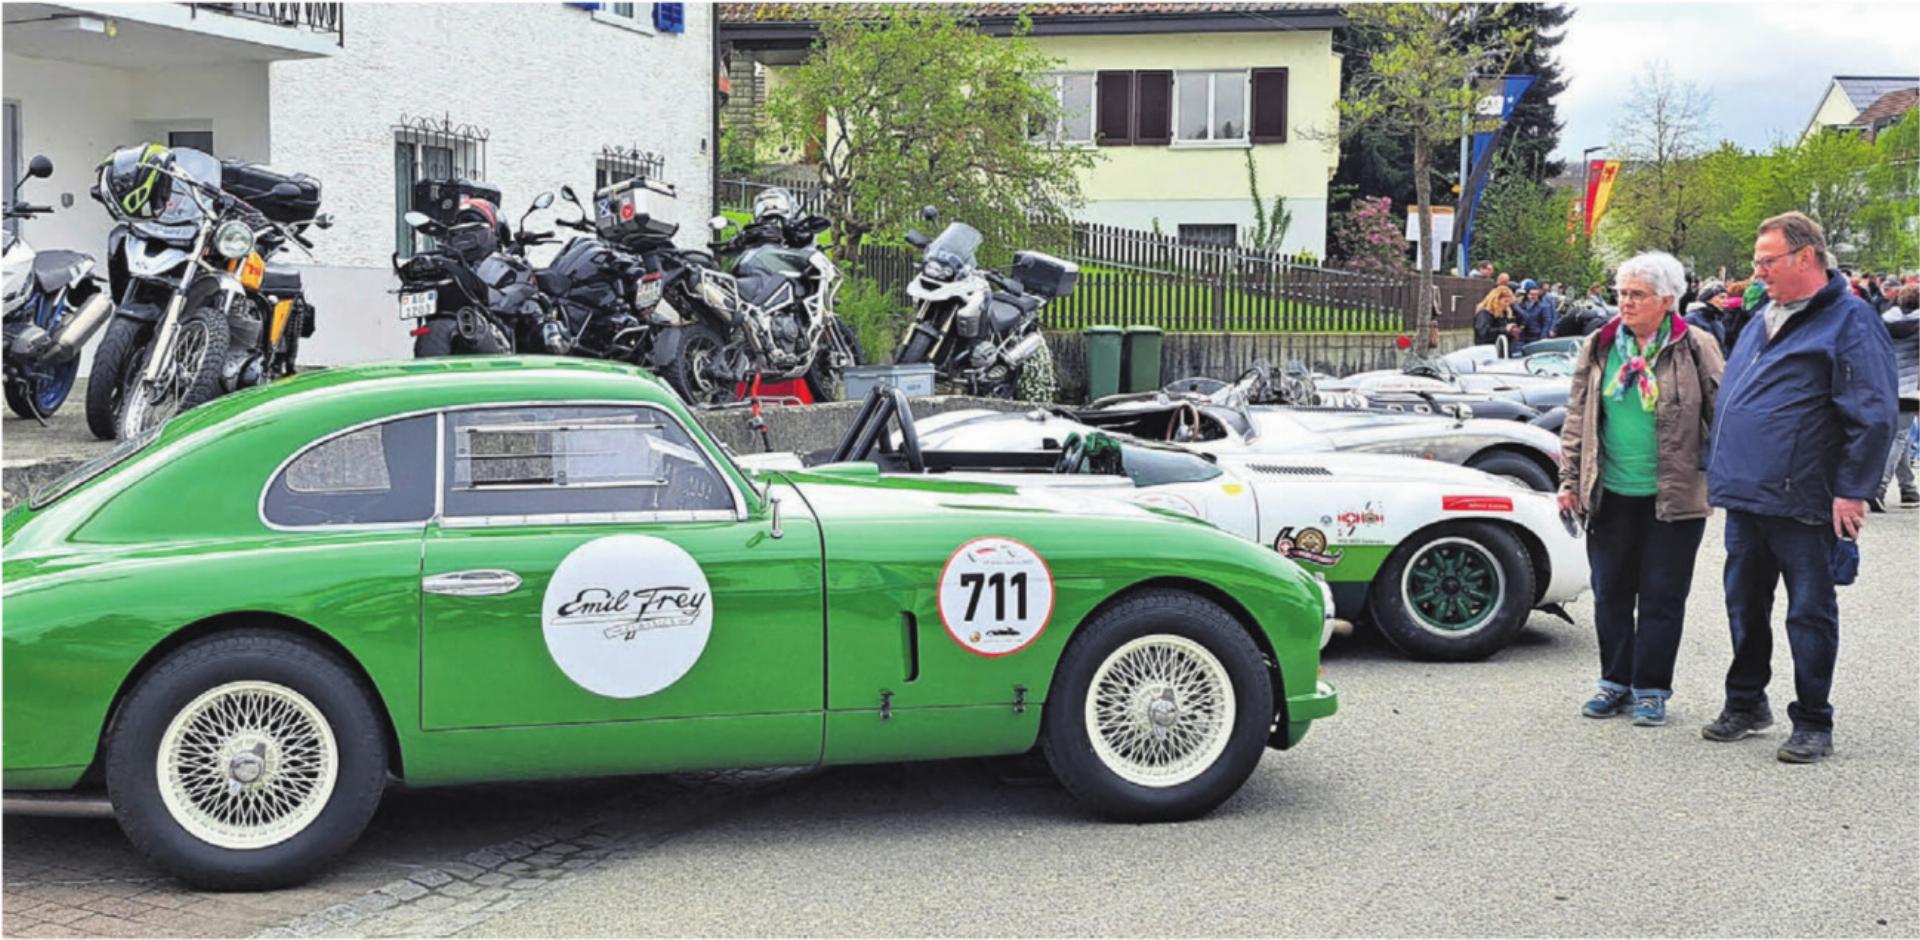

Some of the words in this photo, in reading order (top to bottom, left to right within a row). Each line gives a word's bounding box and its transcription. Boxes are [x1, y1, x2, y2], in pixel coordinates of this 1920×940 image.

[557, 588, 630, 617] Emil
[633, 586, 707, 622] Frey
[960, 572, 1027, 622] 711
